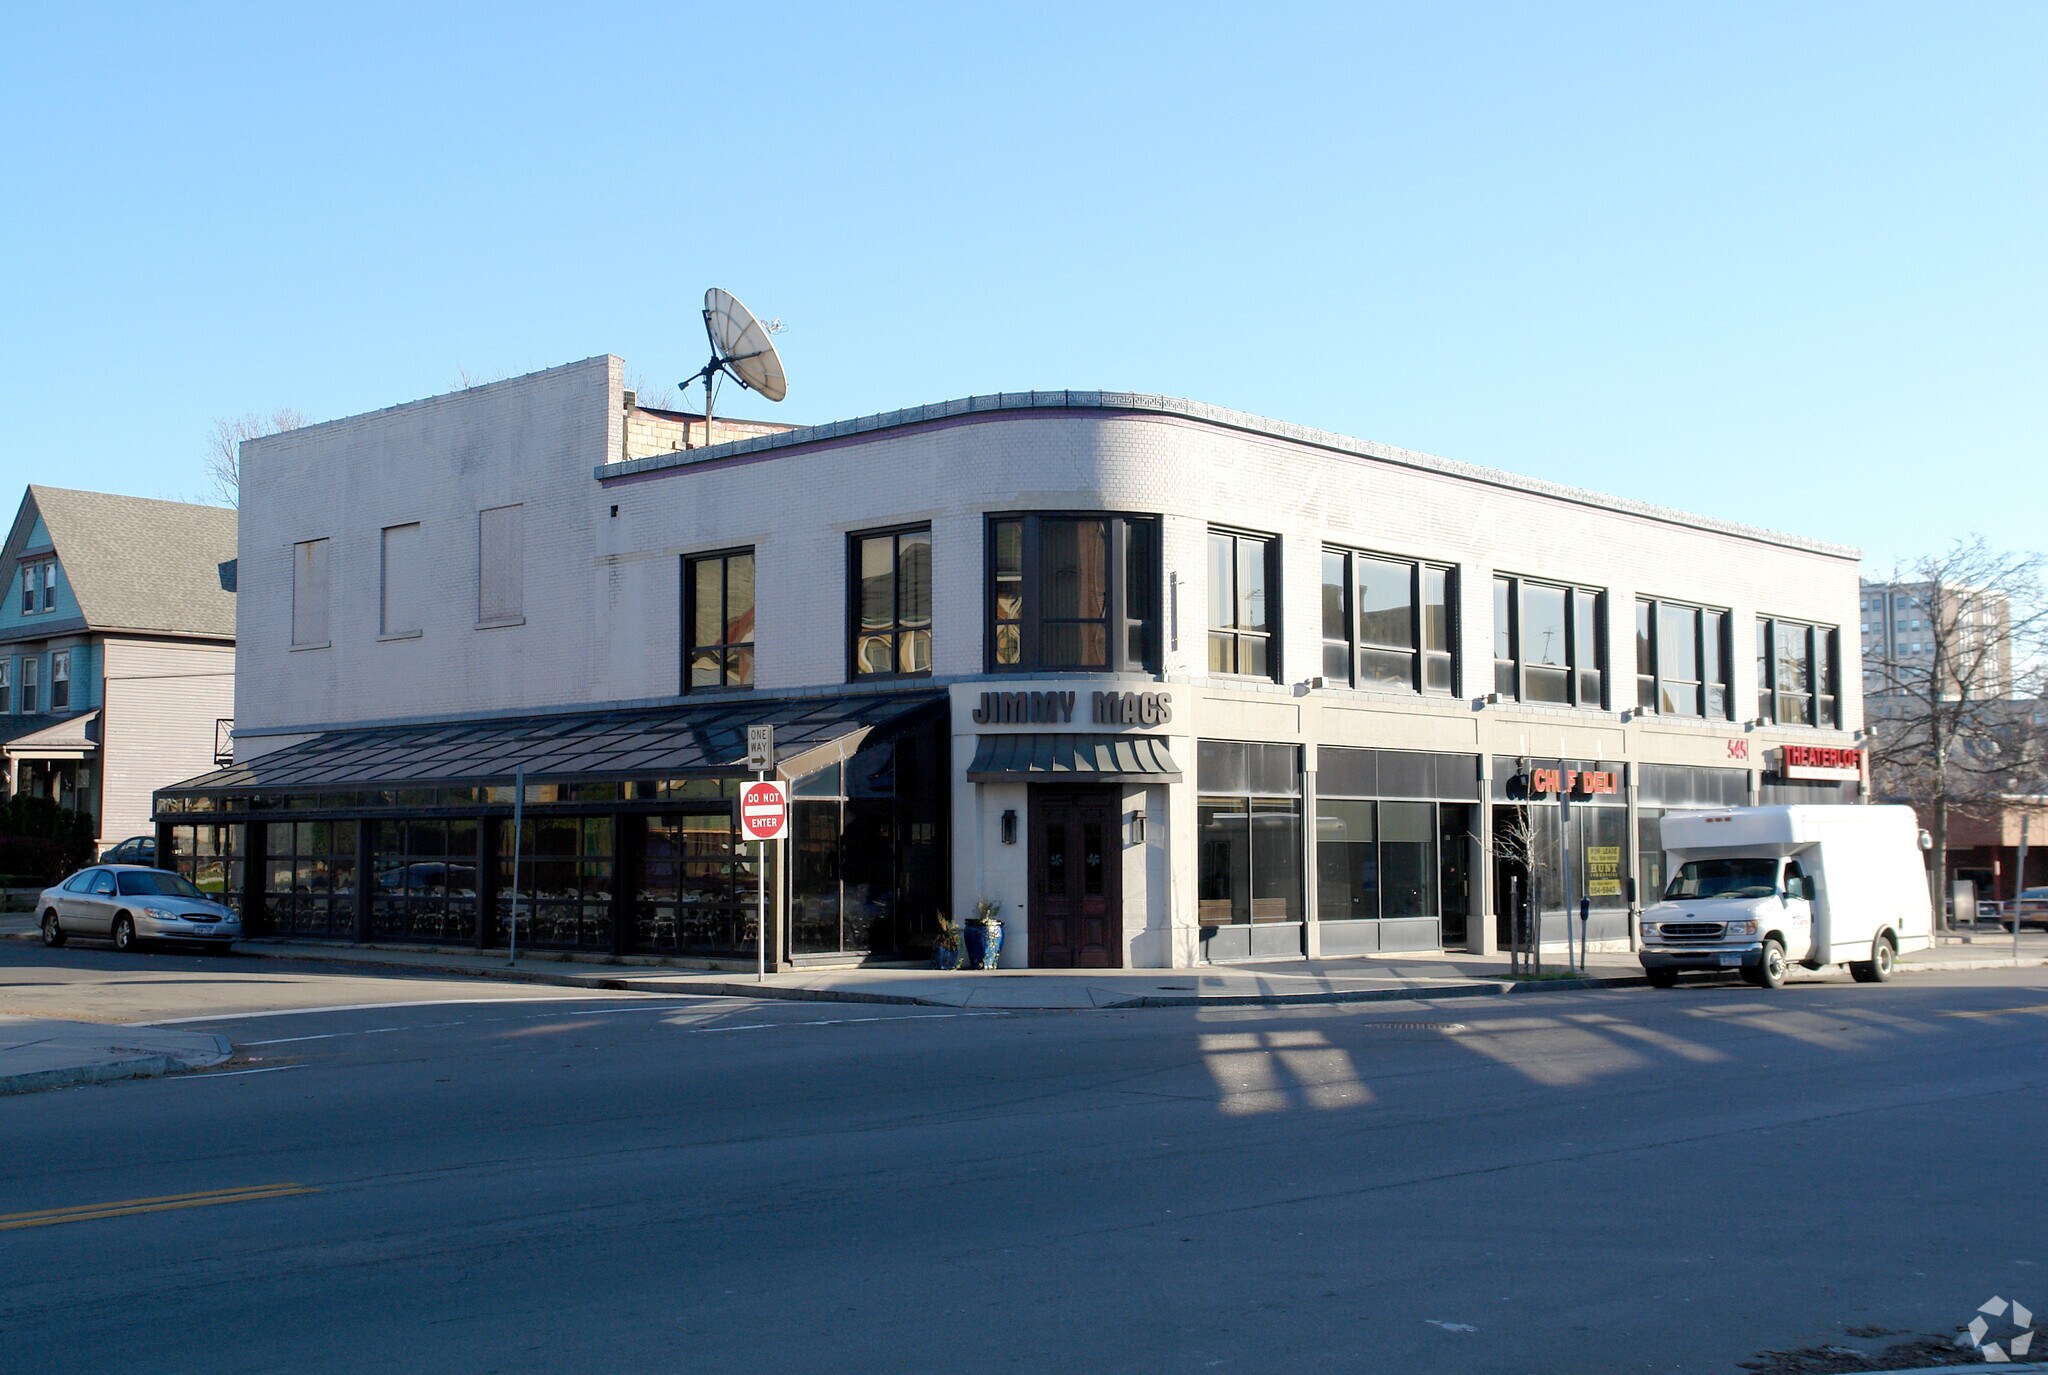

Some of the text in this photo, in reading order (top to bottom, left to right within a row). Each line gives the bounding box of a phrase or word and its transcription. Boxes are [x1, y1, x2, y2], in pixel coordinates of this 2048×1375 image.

[972, 691, 1172, 724] JIMMY MACS
[751, 729, 767, 740] ONE
[751, 742, 768, 753] WAY
[1727, 739, 1747, 759] 545
[1583, 771, 1617, 795] DELI
[748, 793, 779, 803] DO NOT
[752, 818, 777, 828] ENTER
[1590, 863, 1618, 873] HUNT
